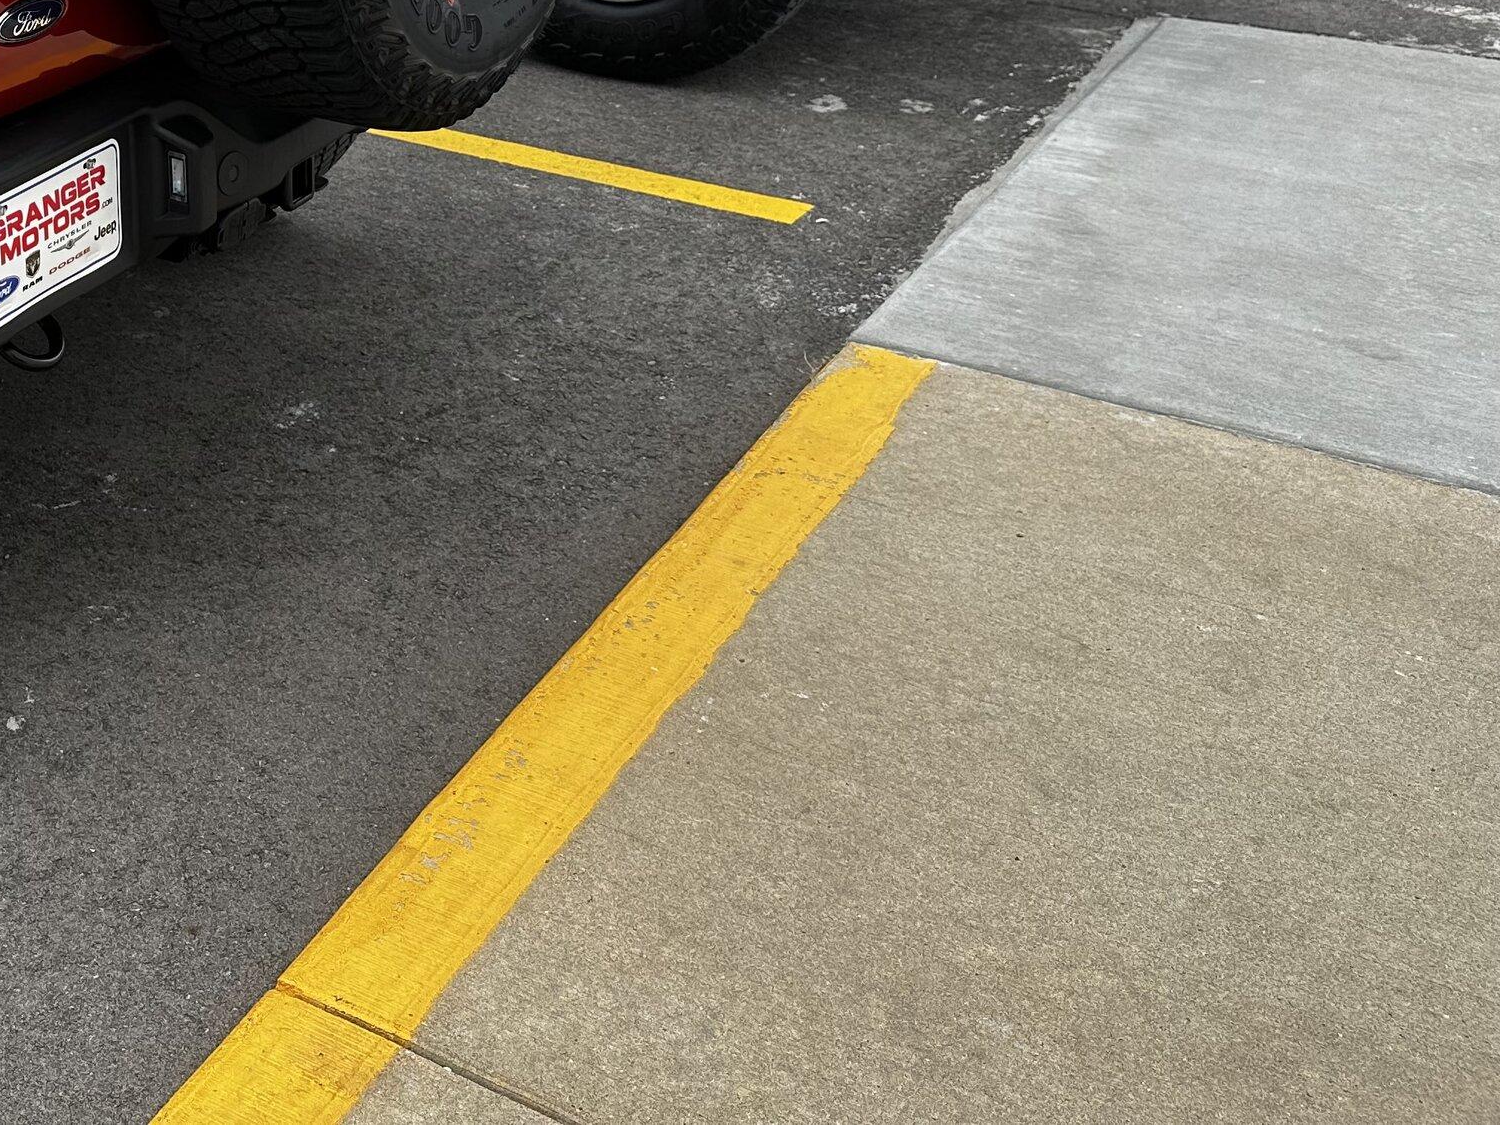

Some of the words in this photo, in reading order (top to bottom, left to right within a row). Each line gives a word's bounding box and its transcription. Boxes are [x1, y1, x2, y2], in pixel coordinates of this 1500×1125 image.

[13, 7, 53, 36] Ford
[0, 192, 101, 266] MOTORS
[47, 220, 92, 249] CHRYSLER
[94, 220, 117, 241] Jeep
[49, 246, 91, 275] DODGE
[22, 276, 43, 292] RAM
